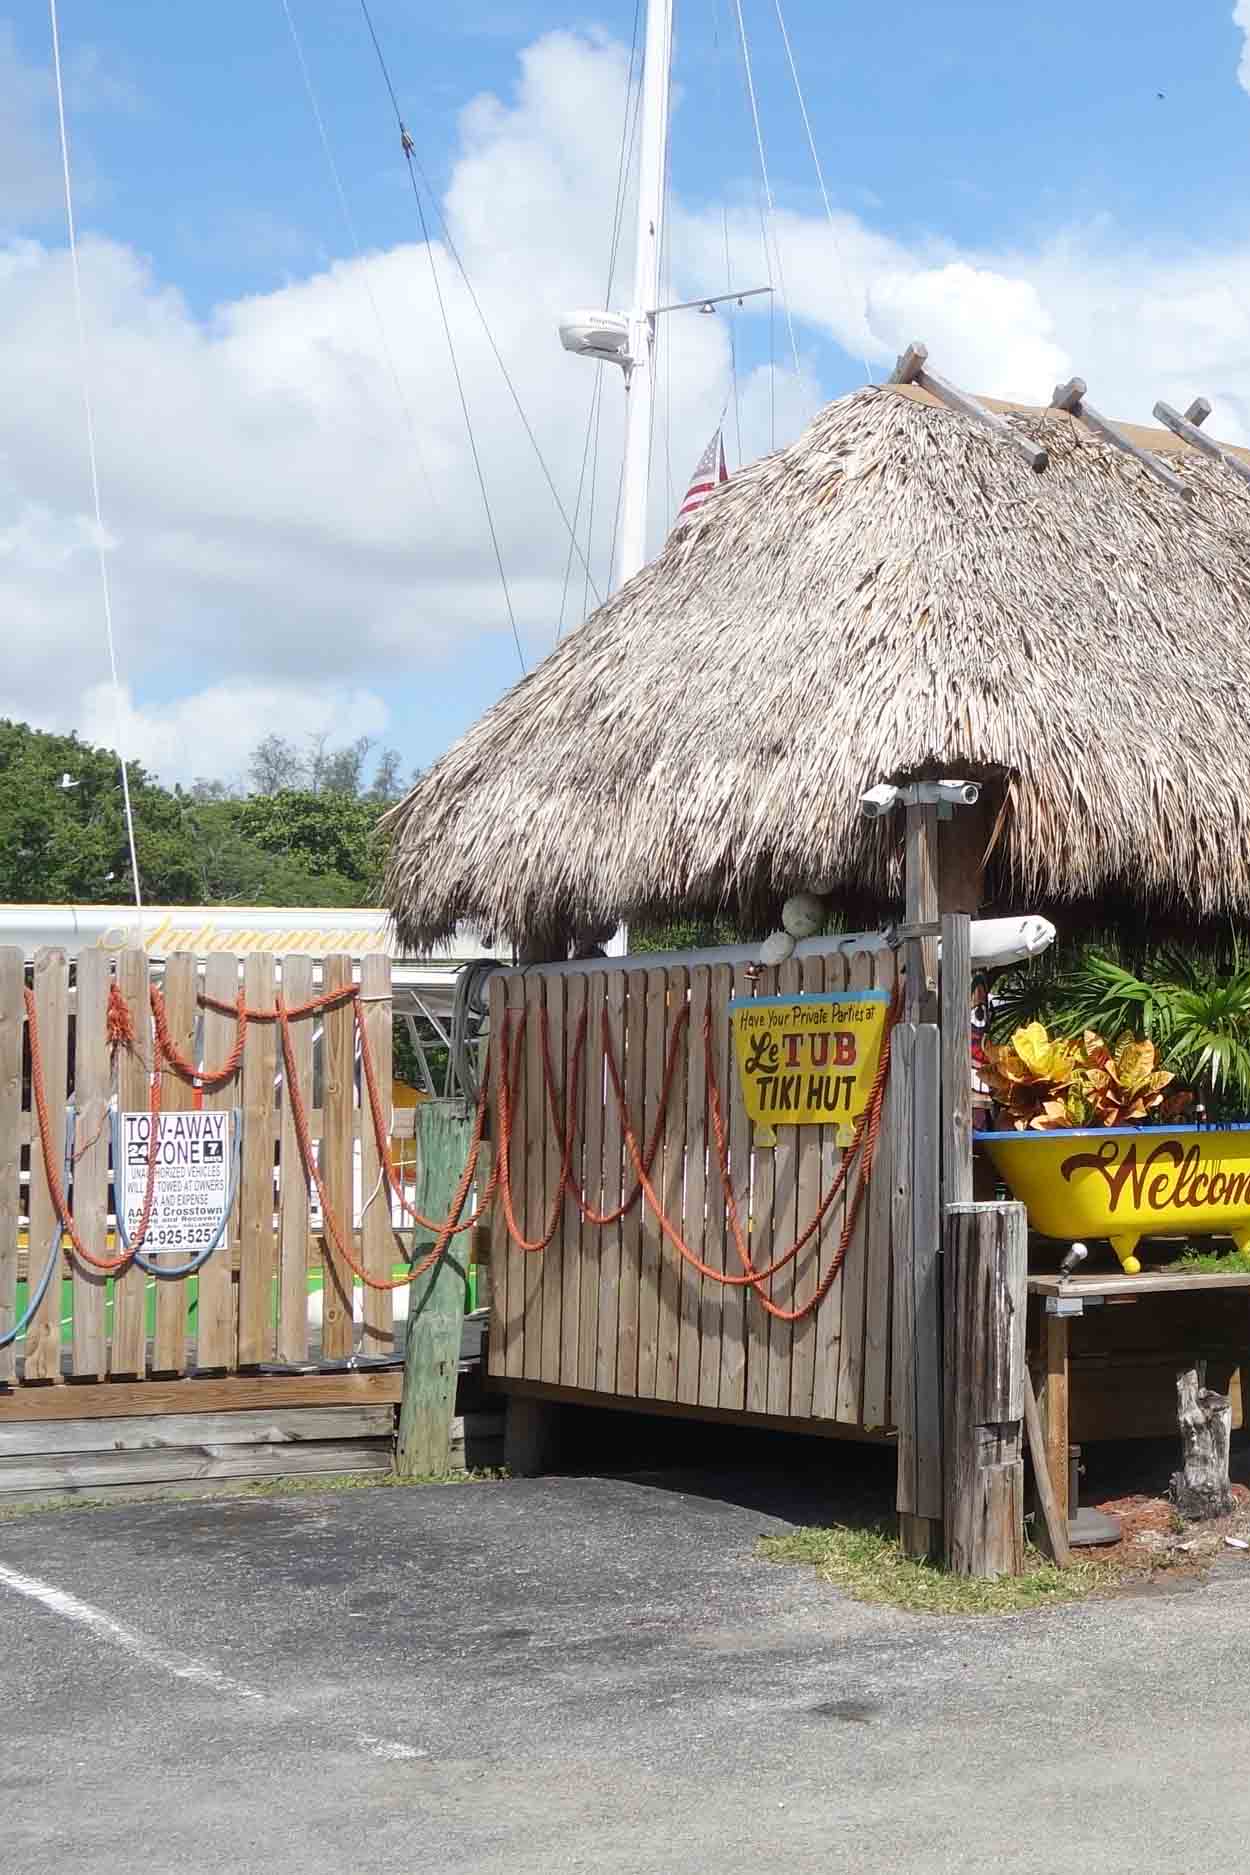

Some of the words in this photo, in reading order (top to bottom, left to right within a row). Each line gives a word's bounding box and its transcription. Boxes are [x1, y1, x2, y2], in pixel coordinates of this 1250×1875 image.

[741, 1010, 764, 1030] Have
[767, 1009, 789, 1028] Your
[792, 1006, 828, 1026] Private
[832, 1002, 863, 1023] Parties
[865, 1007, 875, 1020] at
[745, 1032, 779, 1074] Le
[783, 1032, 857, 1067] TUB
[756, 1075, 801, 1110] TIKI
[807, 1075, 856, 1111] HUT
[163, 1207, 222, 1217] Crosstown
